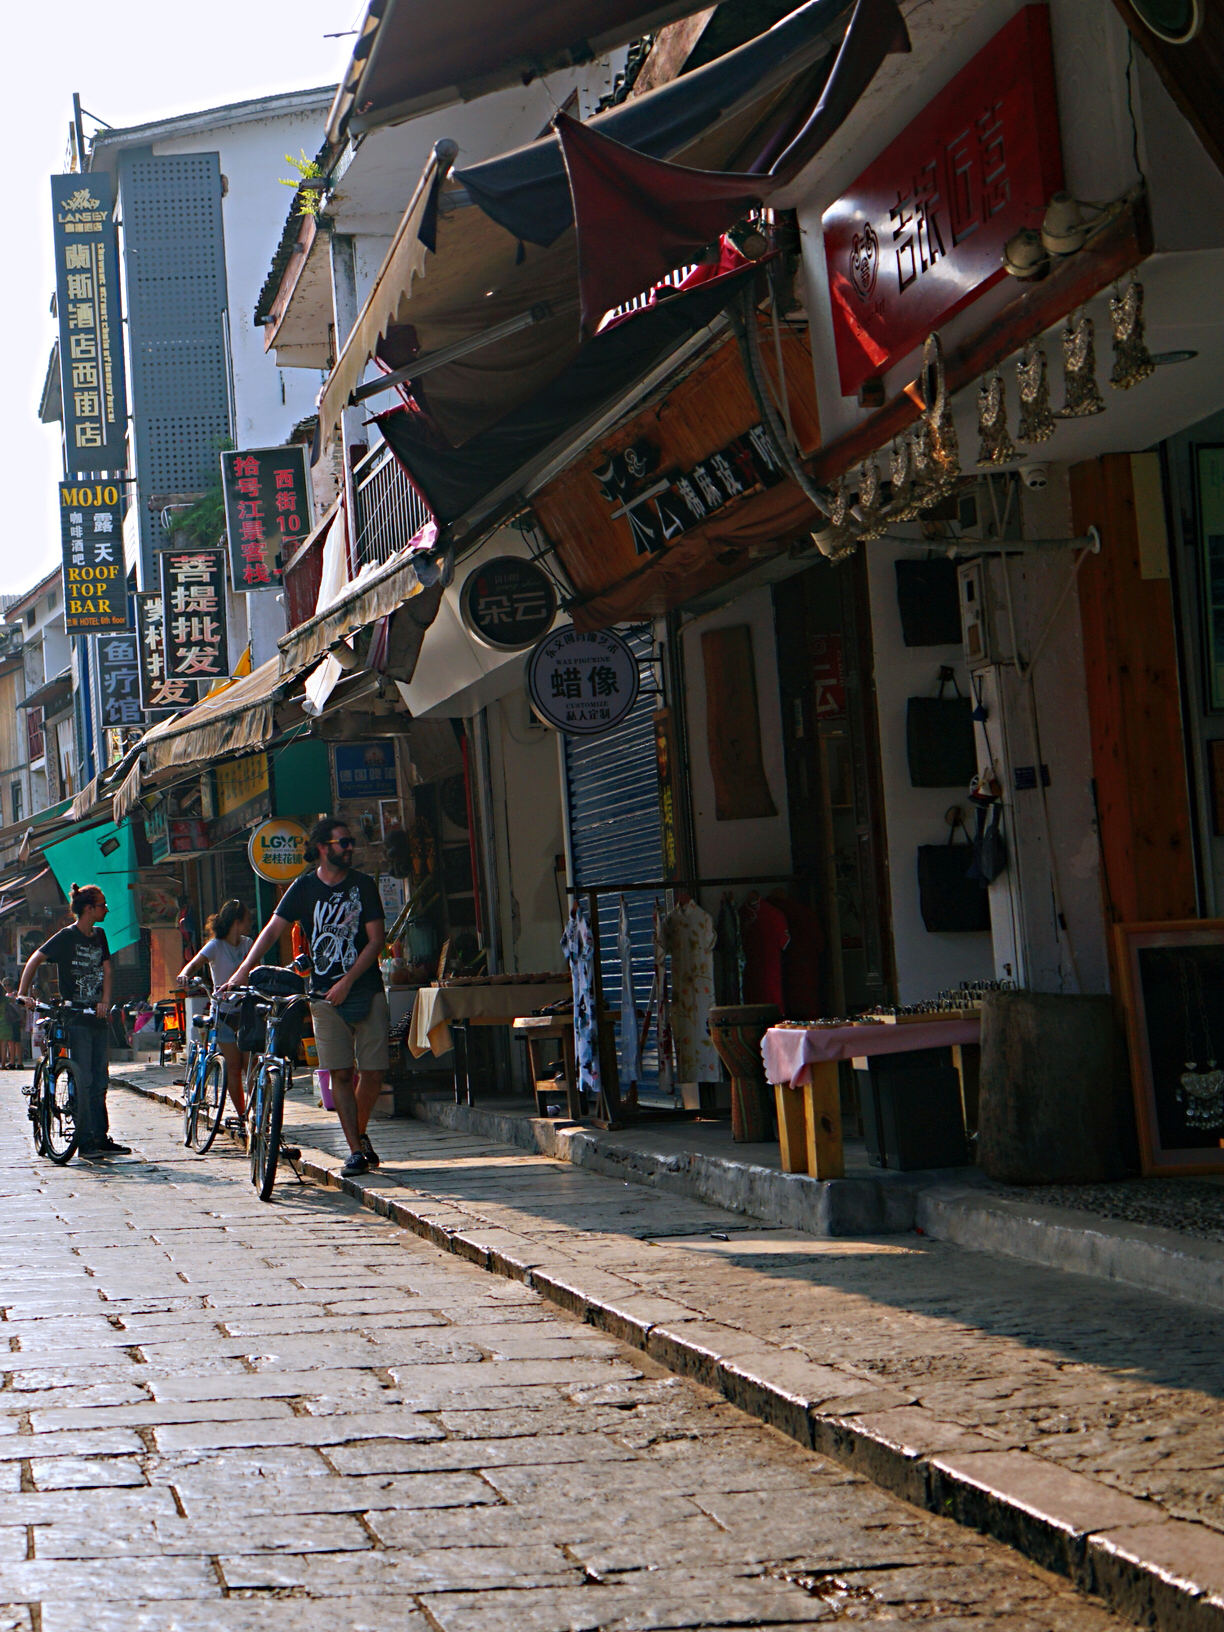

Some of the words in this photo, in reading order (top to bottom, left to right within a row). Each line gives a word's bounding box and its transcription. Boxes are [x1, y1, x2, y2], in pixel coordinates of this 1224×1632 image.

[58, 211, 108, 223] LANSEY
[61, 485, 118, 507] MOJO
[233, 455, 271, 584] 拾号江景客栈
[69, 511, 86, 566] 咖啡酒吧
[93, 512, 114, 563] 露天
[68, 566, 119, 581] ROOF
[69, 583, 107, 597] TOP
[70, 600, 112, 614] BAR
[169, 555, 221, 674] 菩提批发
[478, 591, 547, 626] 朵云
[144, 598, 191, 705] 紫发
[104, 641, 140, 722] 鱼疗馆
[550, 665, 620, 699] 蜡像
[566, 708, 610, 721] 私人定制
